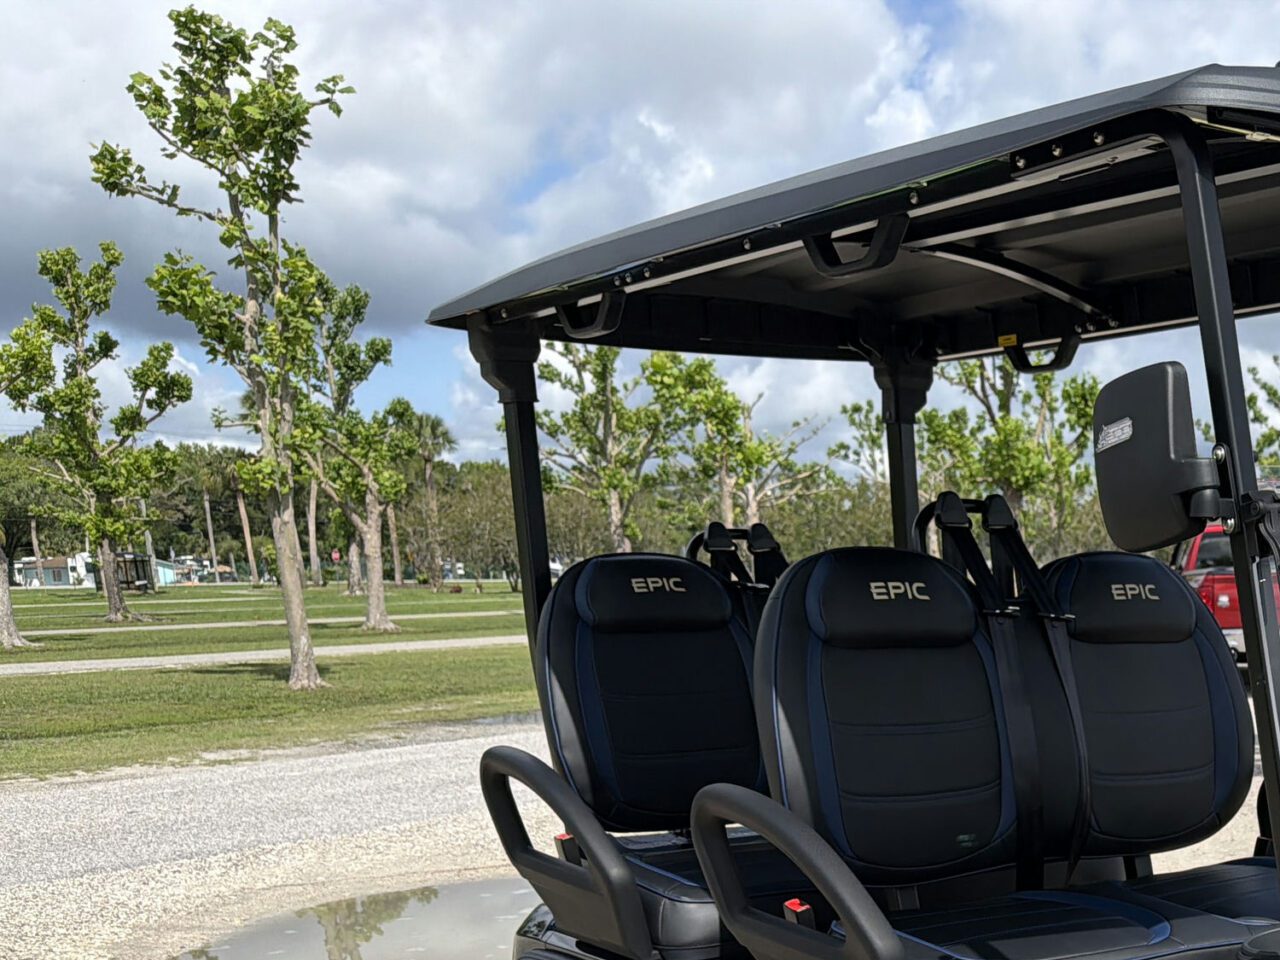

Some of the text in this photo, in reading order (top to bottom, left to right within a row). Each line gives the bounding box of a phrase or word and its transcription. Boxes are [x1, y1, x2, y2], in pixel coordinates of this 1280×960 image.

[631, 577, 687, 593] EPIC
[869, 581, 931, 600] EPIC
[1111, 584, 1160, 600] EPIC
